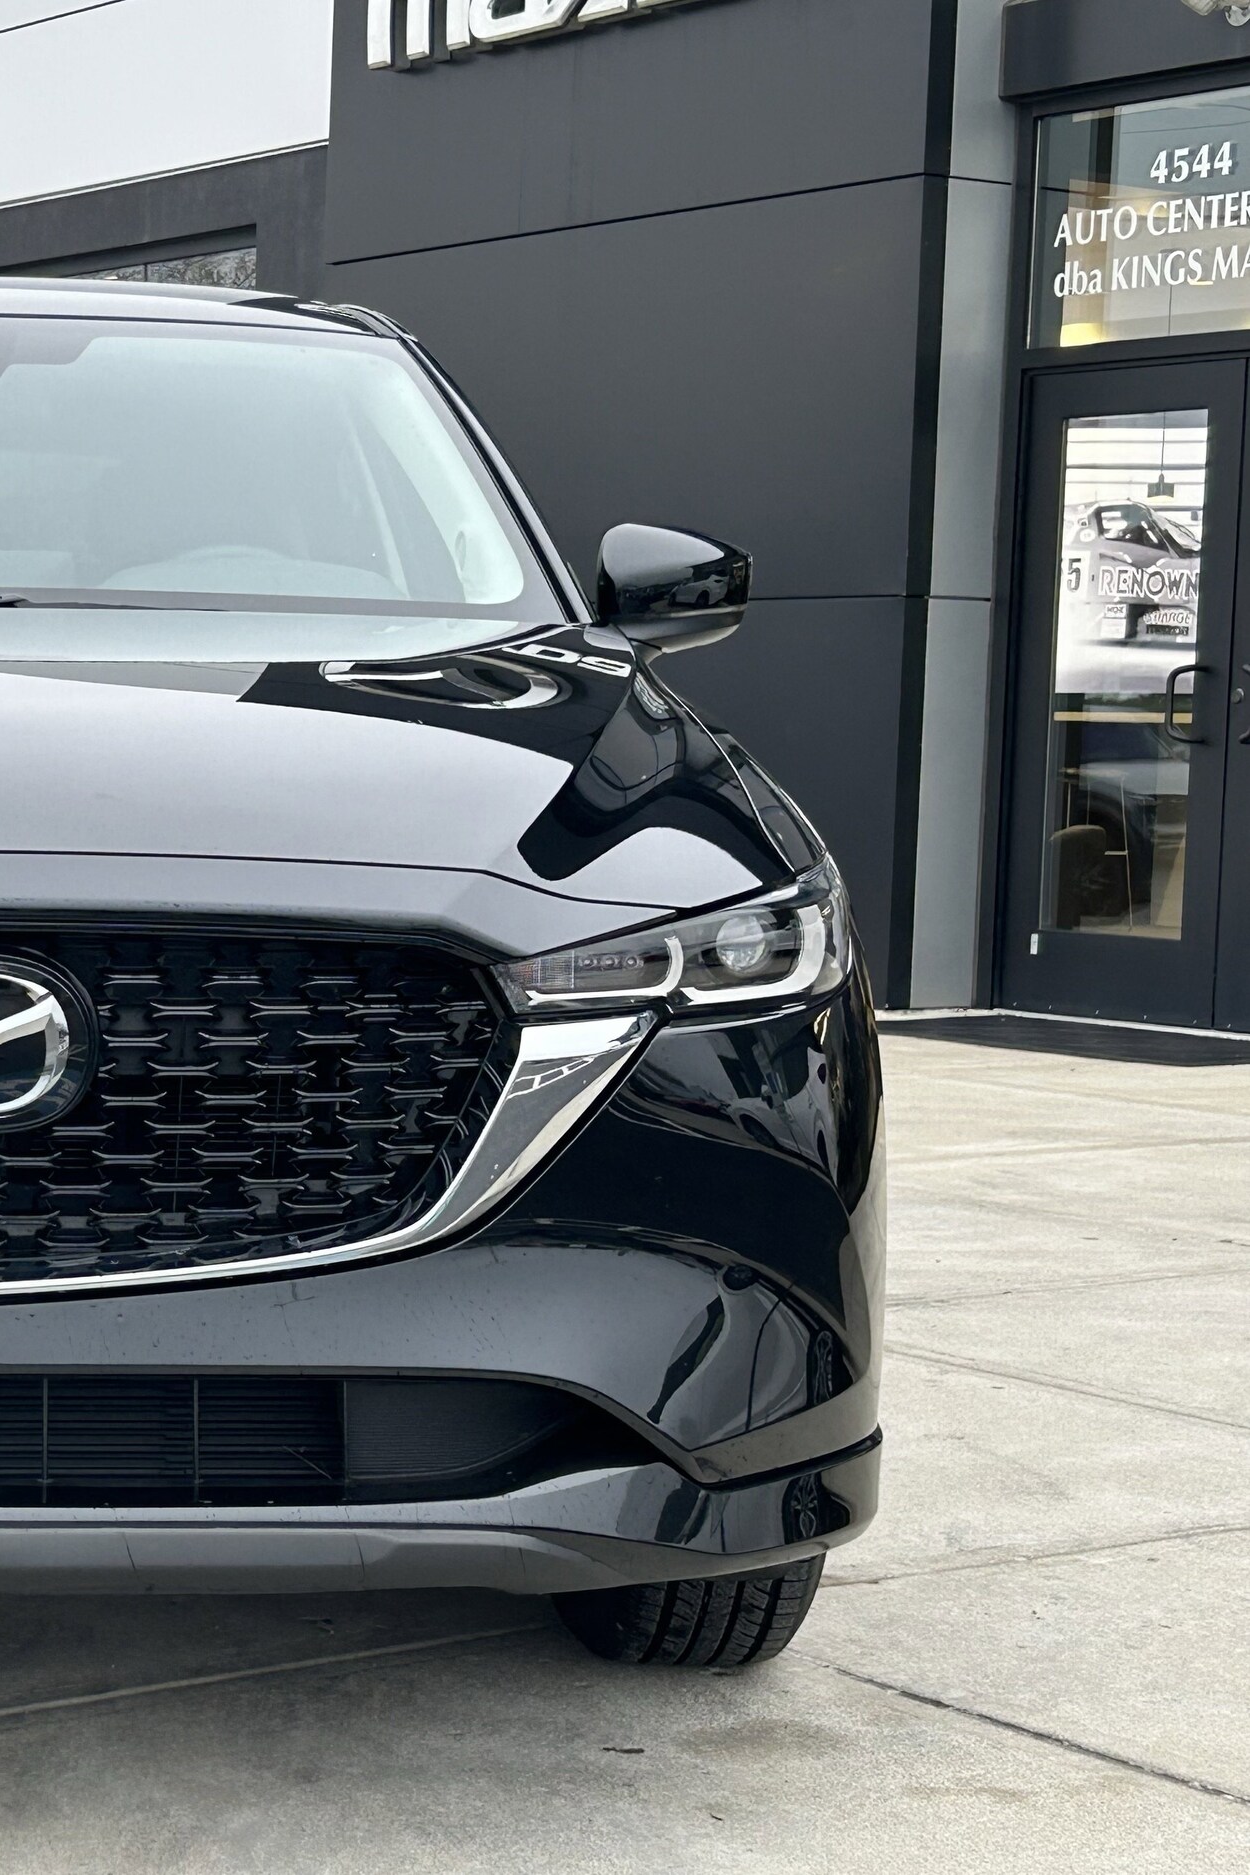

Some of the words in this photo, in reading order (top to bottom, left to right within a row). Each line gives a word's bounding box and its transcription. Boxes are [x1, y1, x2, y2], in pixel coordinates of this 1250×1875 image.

[1150, 141, 1233, 184] 4544
[1053, 205, 1138, 247] AUTO
[1147, 191, 1250, 236] CENTER
[1053, 261, 1102, 297] dba
[1111, 248, 1203, 291] KINGS
[1098, 566, 1199, 599] RENOWN
